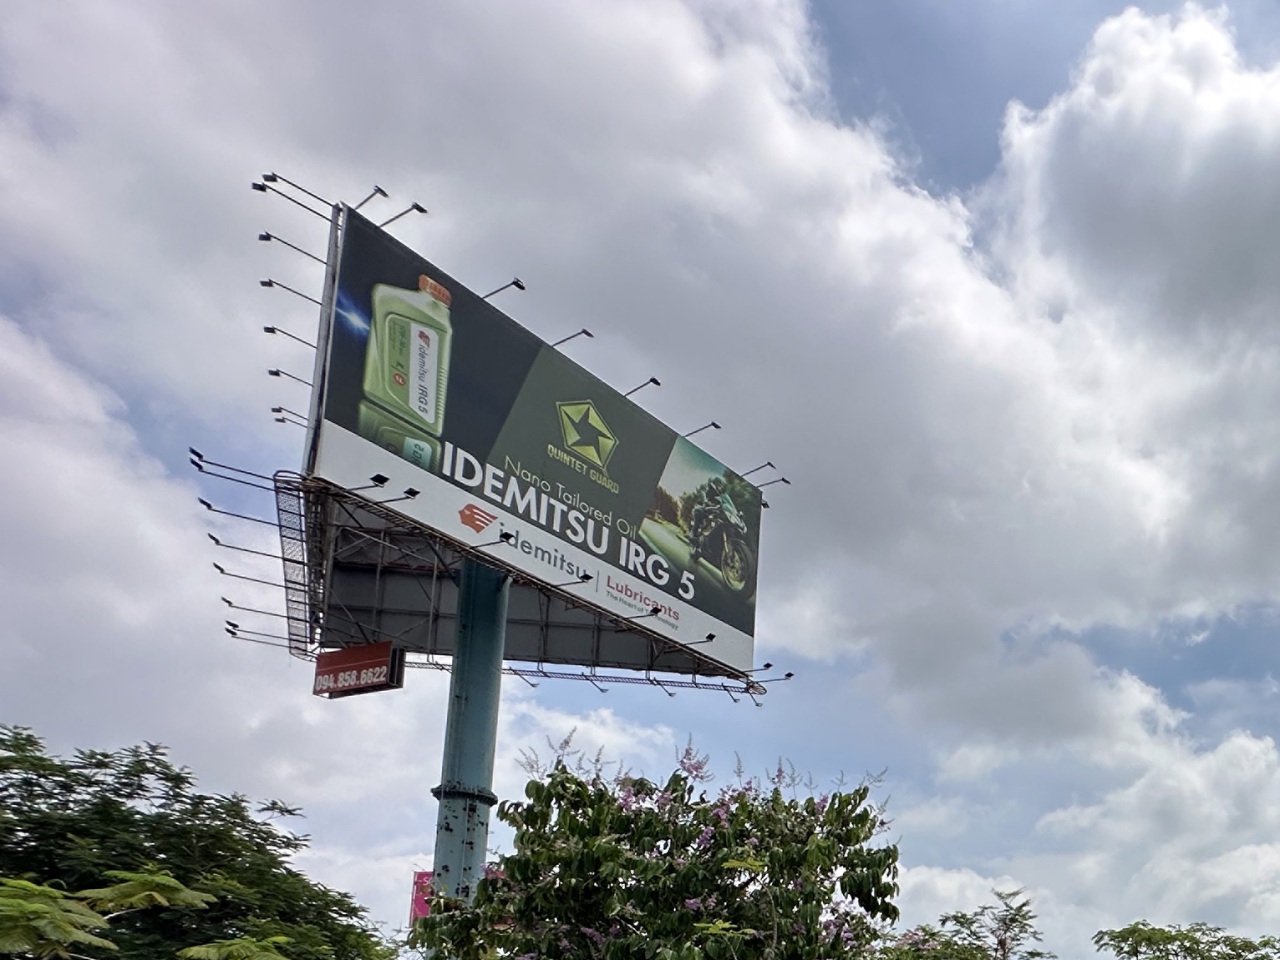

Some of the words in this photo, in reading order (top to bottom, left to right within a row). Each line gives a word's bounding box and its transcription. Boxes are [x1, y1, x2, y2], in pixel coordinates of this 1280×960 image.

[418, 343, 428, 383] idemitsu
[418, 384, 429, 405] IRG
[419, 406, 429, 414] 5
[547, 444, 588, 475] QUINTET
[589, 469, 619, 494] GUARD
[442, 441, 609, 555] IDEMITSU
[619, 536, 670, 586] IRG
[678, 570, 695, 600] 5
[504, 455, 551, 492] Nano
[556, 482, 613, 526] Tailored
[616, 518, 636, 540] Oil
[499, 522, 588, 582] idemitsu
[606, 575, 680, 621] Lubricants
